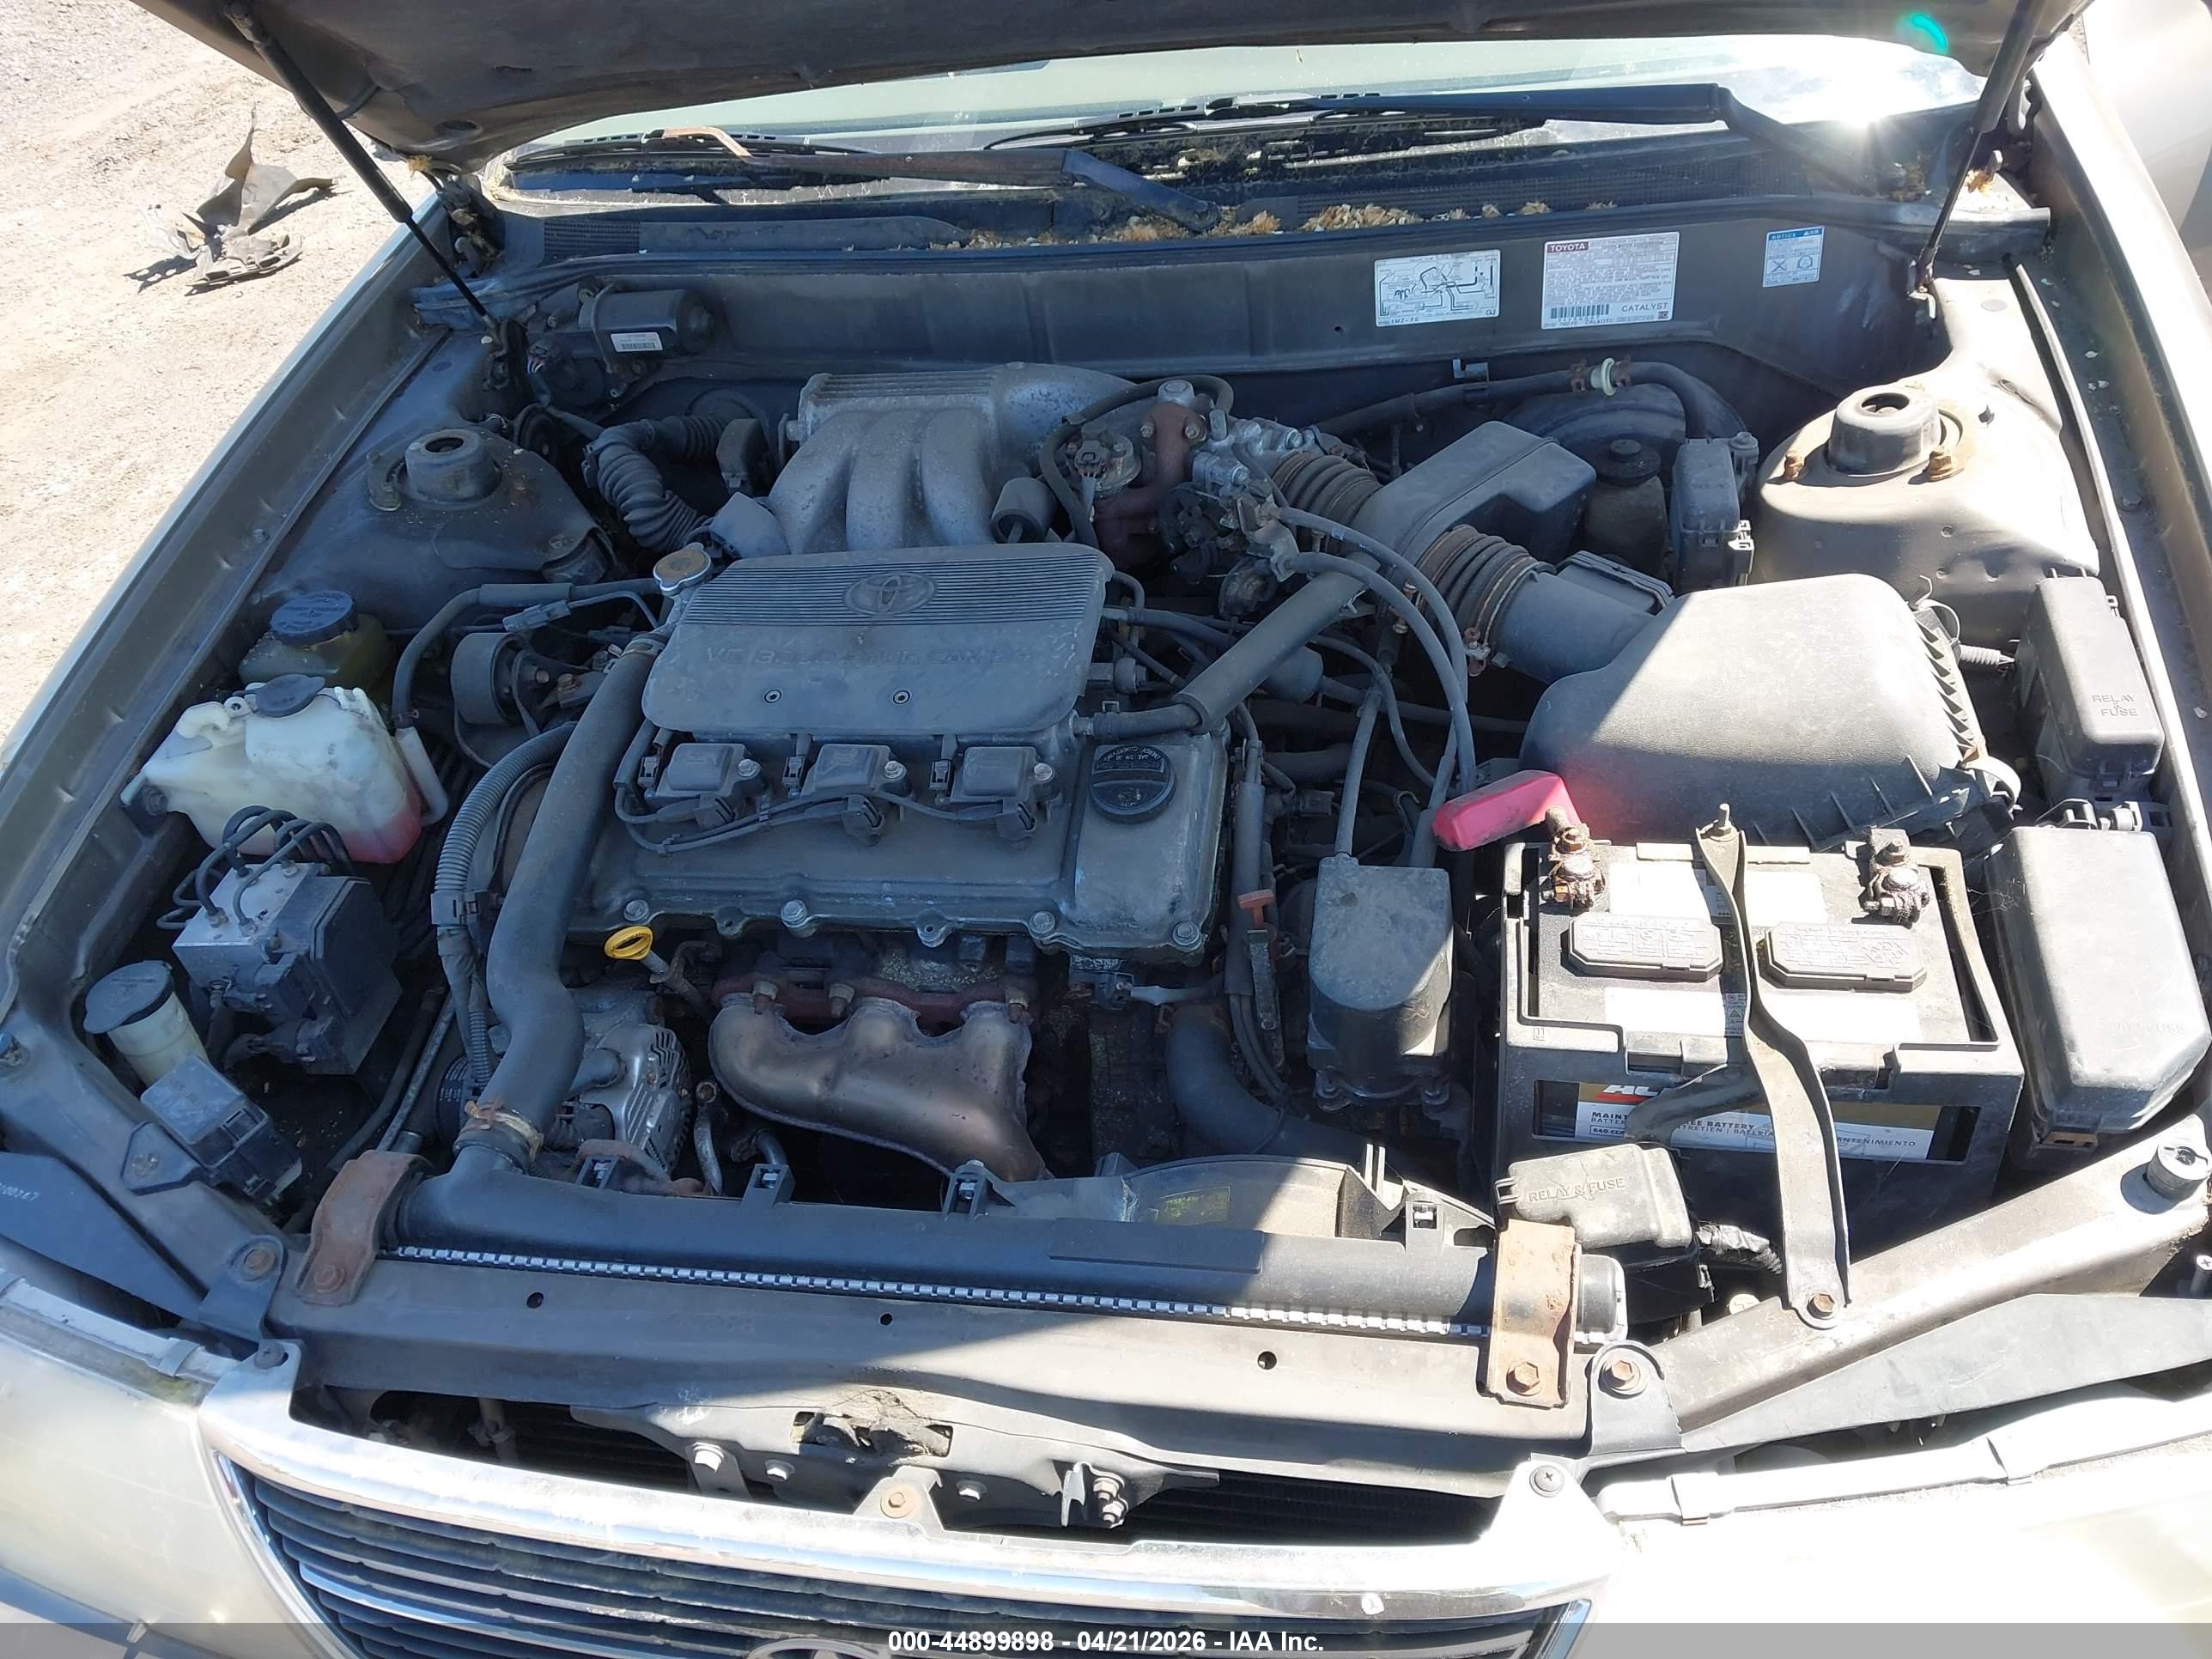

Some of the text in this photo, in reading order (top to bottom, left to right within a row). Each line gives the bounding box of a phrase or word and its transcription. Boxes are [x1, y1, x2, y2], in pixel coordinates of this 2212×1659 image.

[1550, 242, 1586, 252] TOYOTA
[1621, 301, 1668, 313] CATALYST
[2091, 694, 2136, 702] RELAY
[1706, 1120, 1755, 1130] BATTERY
[1528, 1185, 1570, 1202] RELAY
[1589, 1177, 1626, 1193] FUSE
